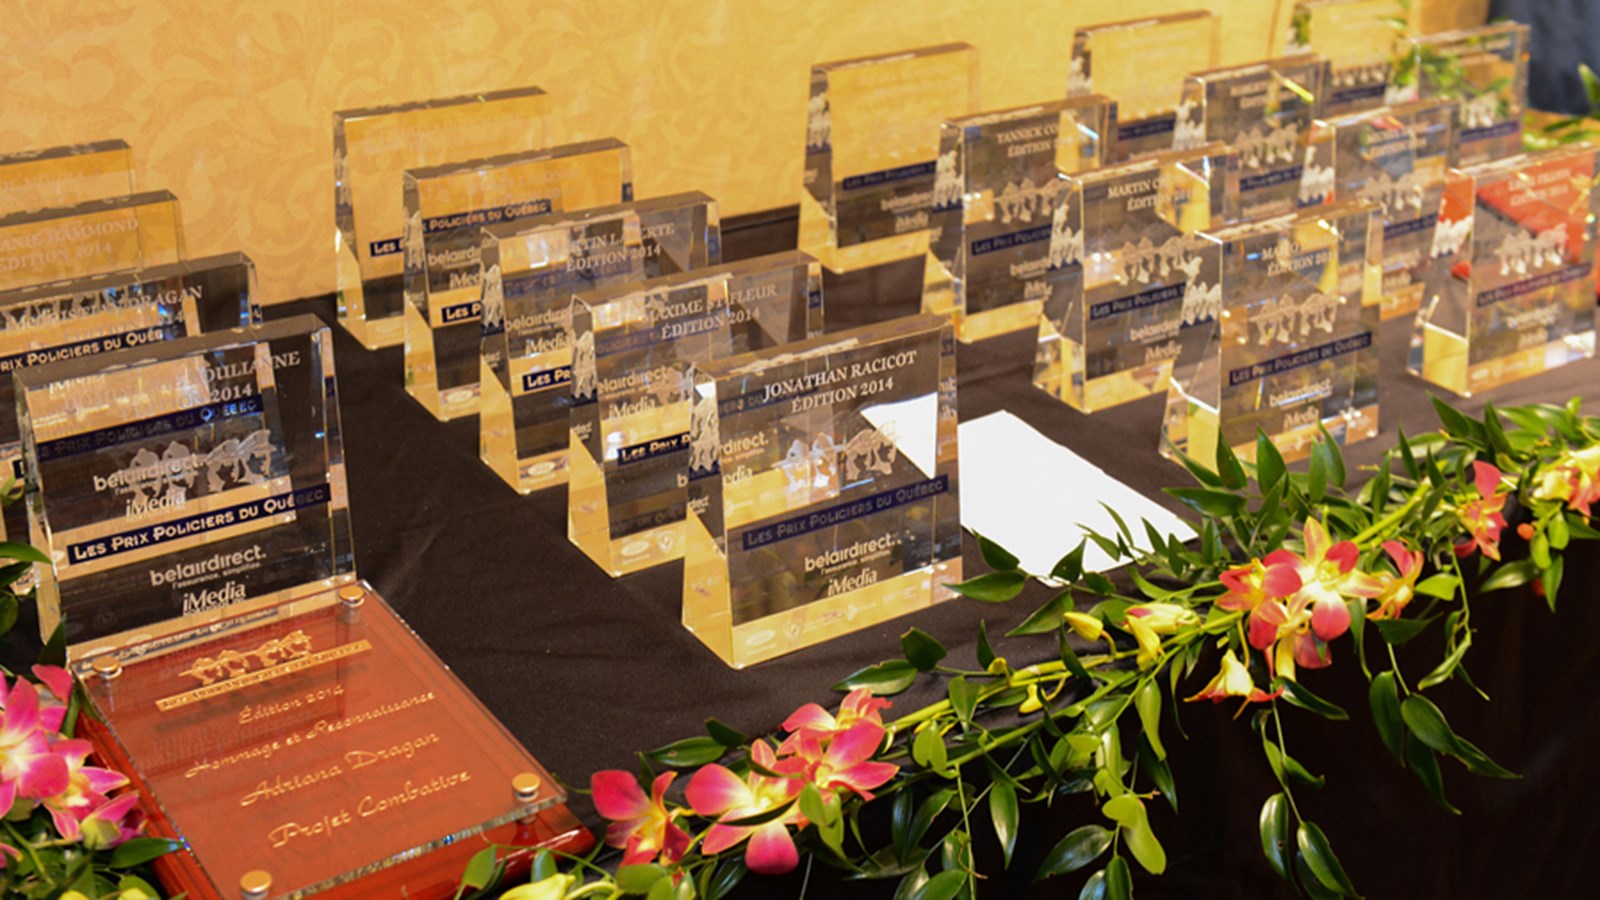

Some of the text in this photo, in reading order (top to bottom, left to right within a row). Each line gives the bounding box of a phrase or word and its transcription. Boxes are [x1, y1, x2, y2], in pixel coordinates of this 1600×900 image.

[1107, 179, 1150, 199] MARTIN
[567, 243, 661, 272] ÉDITION 2014
[446, 307, 470, 320] LES
[661, 315, 725, 340] ÉDITION
[729, 307, 760, 324] 2014
[27, 342, 100, 367] POLICIERS
[104, 337, 121, 351] DU
[210, 383, 252, 402] 2014
[527, 373, 551, 388] LES
[763, 350, 918, 403] JONATHAN RACICOT
[791, 377, 895, 414] ÉDITION 2014
[74, 488, 325, 560] LES PRIX POLICIERS DU QUÉBEC
[748, 480, 944, 546] LES PRIX POLICIERS DU QUÉBEC
[182, 581, 247, 614] iMedia
[828, 567, 877, 597] iMedia
[239, 684, 345, 725] Édition 2014
[184, 690, 436, 779] Hommage et Reconnaissance
[241, 732, 441, 808] Adriana Dragan
[267, 768, 472, 849] Projet Combative
